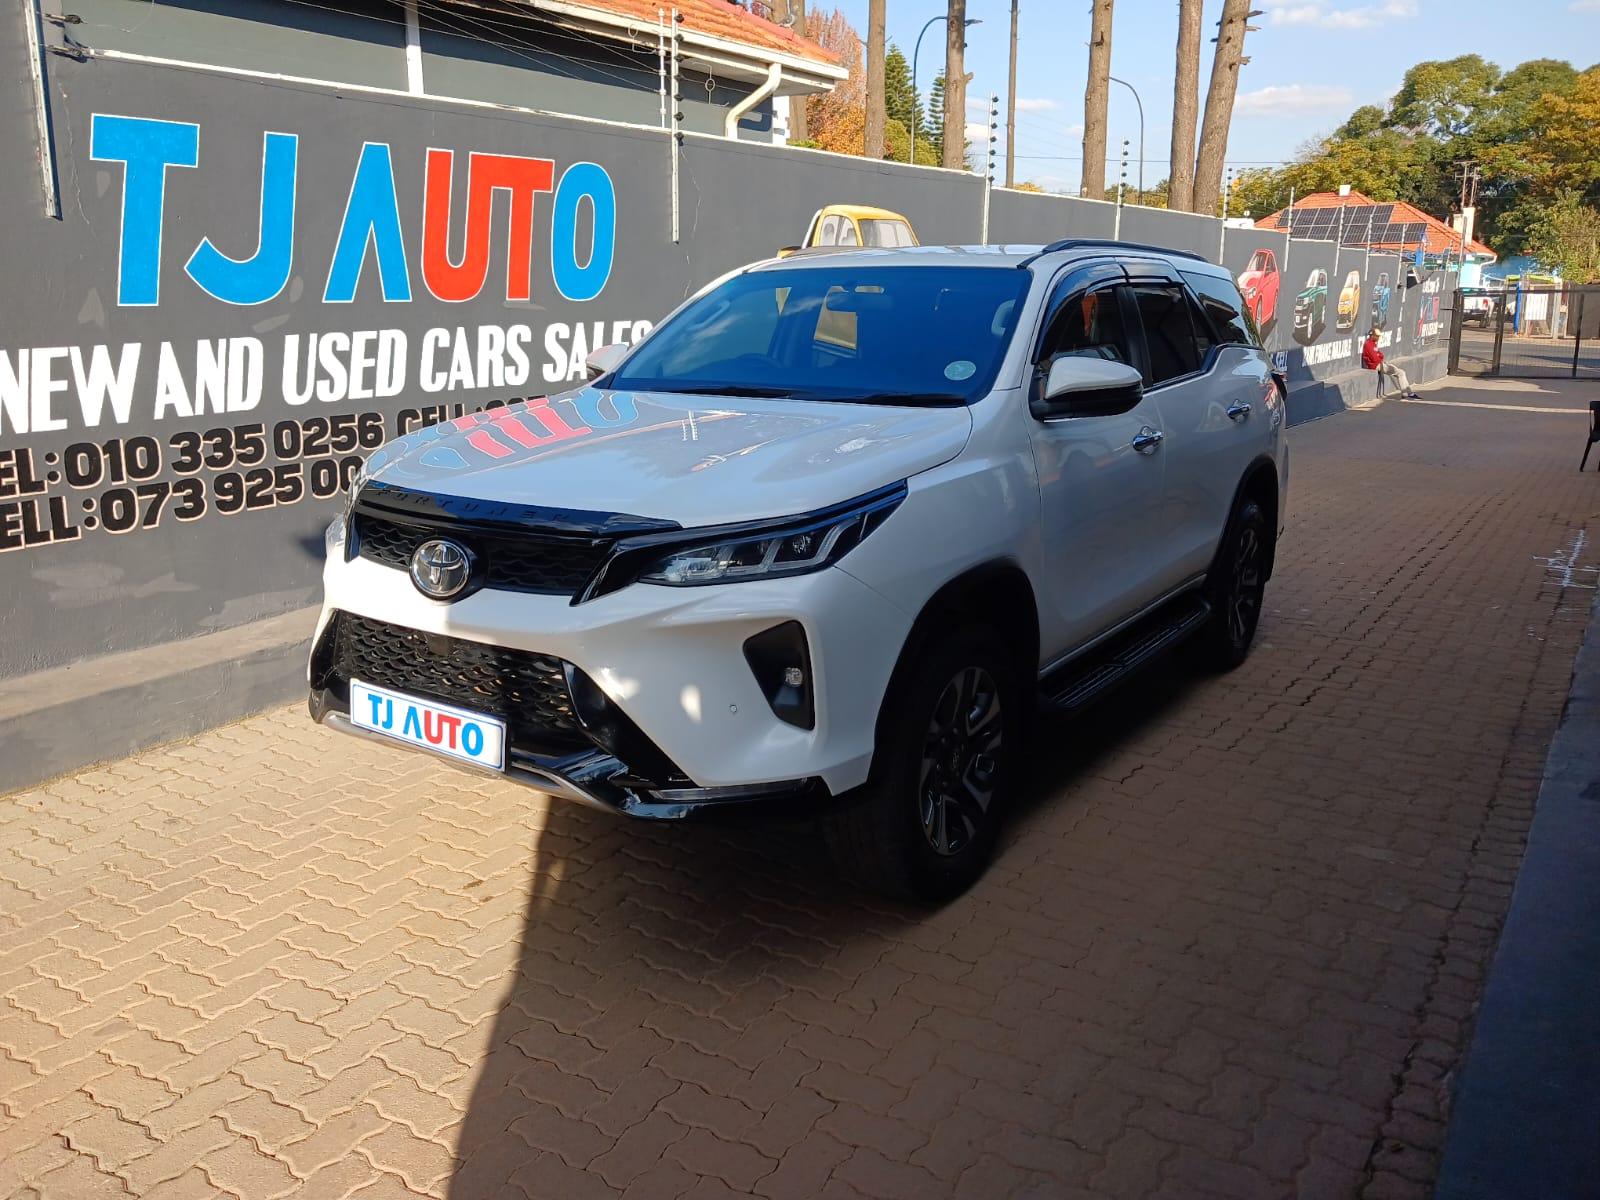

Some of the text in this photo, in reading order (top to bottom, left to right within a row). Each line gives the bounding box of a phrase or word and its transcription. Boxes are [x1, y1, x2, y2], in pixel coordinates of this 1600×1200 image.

[89, 112, 617, 307] TJ AUTO
[0, 342, 142, 434] NEW
[153, 336, 265, 421] AND
[281, 328, 408, 406] USED
[419, 324, 532, 393] CARS
[169, 423, 266, 475] 335
[273, 411, 385, 462] 0256
[213, 462, 304, 515] 925
[367, 693, 484, 757] TJ AUTO
